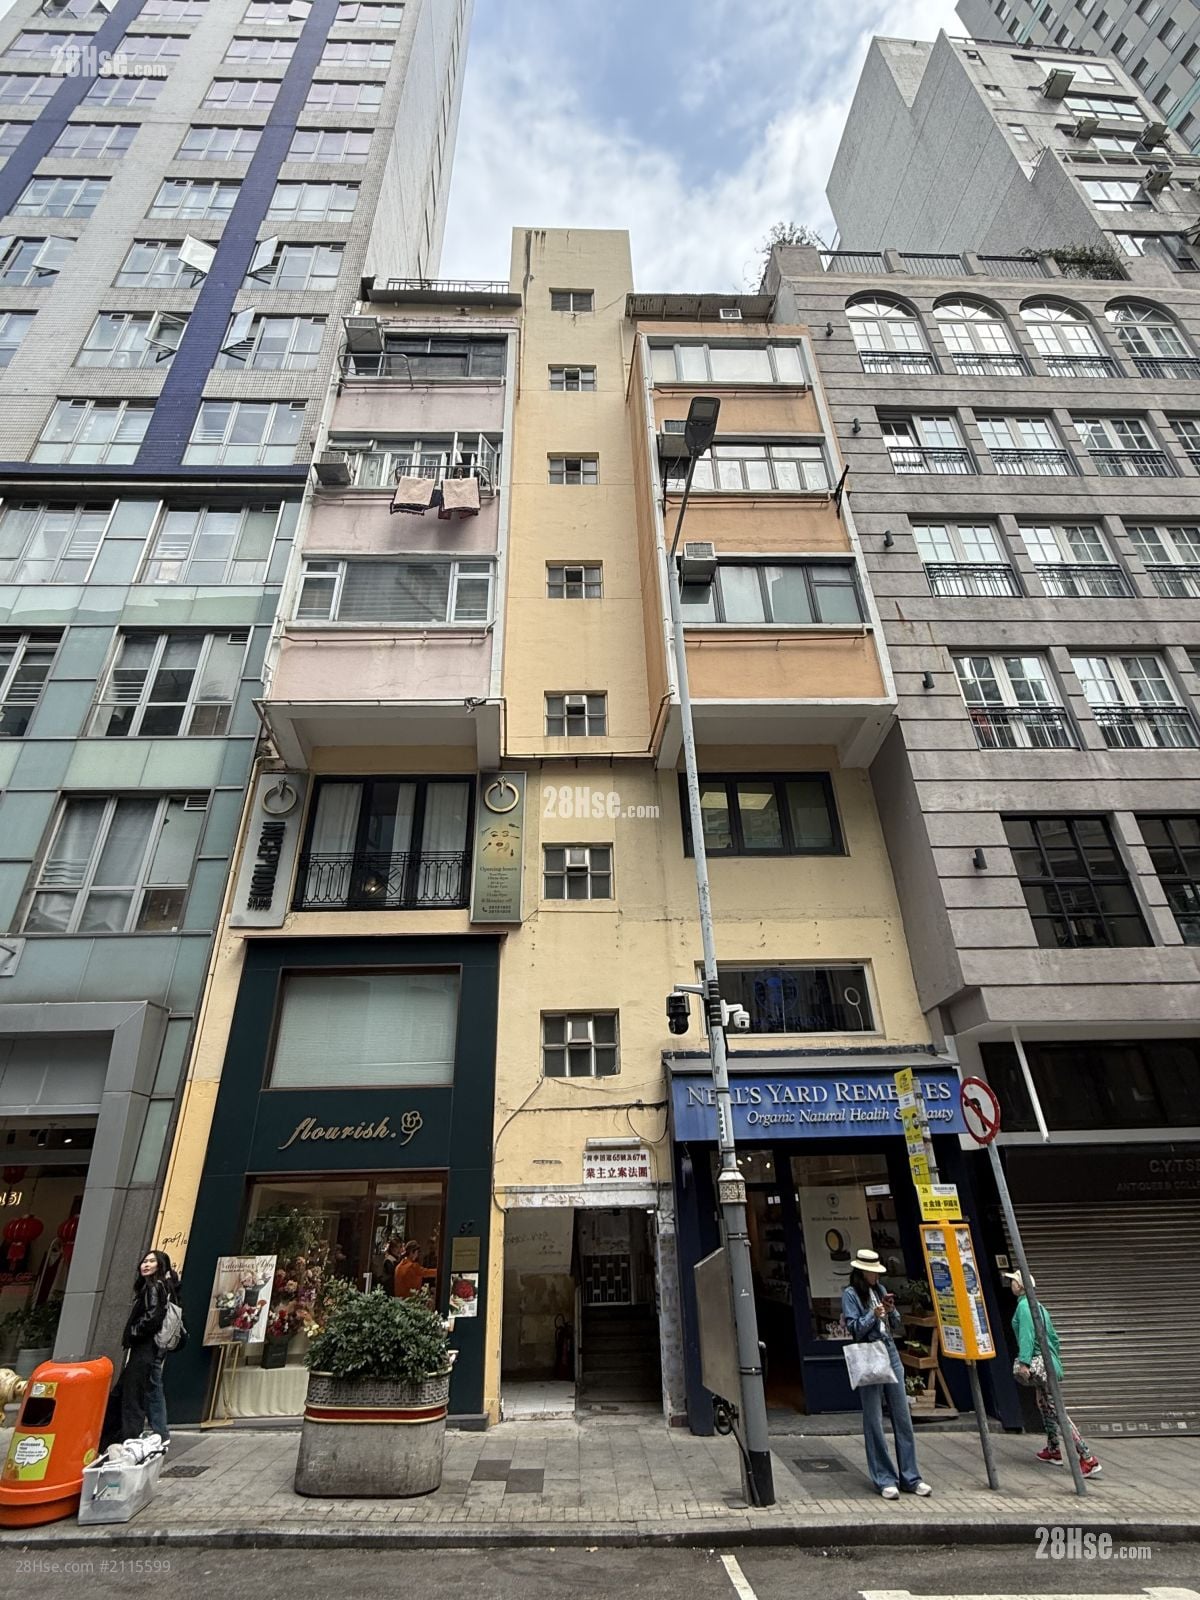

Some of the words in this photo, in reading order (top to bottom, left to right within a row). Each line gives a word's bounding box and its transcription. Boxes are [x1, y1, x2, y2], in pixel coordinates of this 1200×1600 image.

[249, 821, 286, 896] INCEPTION
[686, 1086, 762, 1106] NEL'S
[765, 1083, 828, 1103] YARD
[834, 1082, 951, 1101] REMEES
[747, 1110, 795, 1127] Organic
[799, 1108, 846, 1122] Natural
[849, 1107, 889, 1121] Health
[586, 1166, 648, 1179] 業主立案法團
